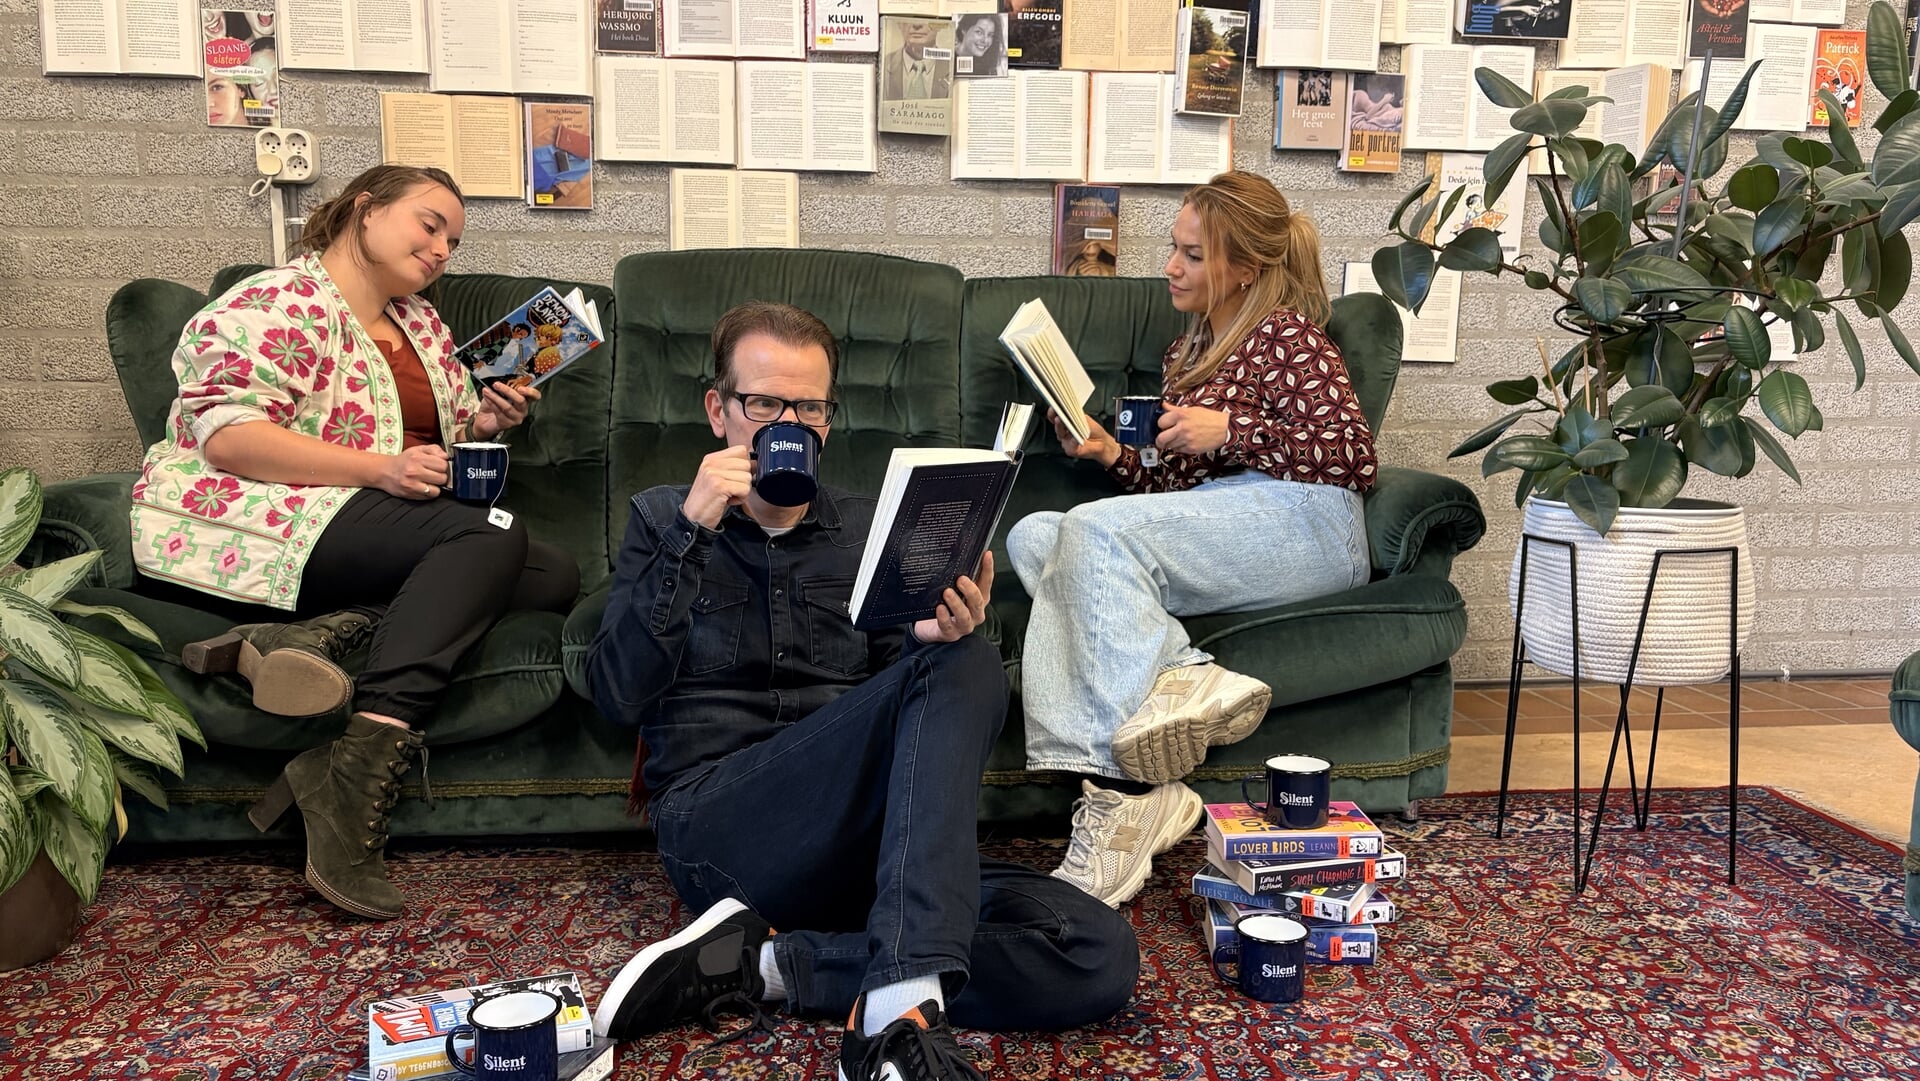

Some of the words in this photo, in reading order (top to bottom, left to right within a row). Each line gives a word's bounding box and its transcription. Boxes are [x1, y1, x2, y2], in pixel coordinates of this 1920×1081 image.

[603, 10, 652, 21] HERBJØRG
[828, 14, 864, 24] KLUUN
[1017, 13, 1061, 21] ERFGOED
[599, 22, 641, 31] WASSMO
[820, 26, 871, 36] HAANTJES
[206, 43, 248, 55] SLOANE
[1825, 41, 1860, 54] Patrick
[213, 54, 242, 65] sisters
[889, 107, 945, 119] SARAMAGO
[1291, 108, 1309, 121] Het
[1311, 110, 1336, 121] grote
[1302, 119, 1323, 128] feest
[1349, 128, 1365, 151] het
[1367, 130, 1400, 156] portret
[1448, 175, 1466, 184] Dede
[531, 299, 563, 327] SLAYER
[542, 294, 572, 320] DEMON
[770, 439, 804, 453] Silent
[467, 467, 497, 479] Silent
[1279, 791, 1314, 805] Silent
[1233, 842, 1268, 855] LOVER
[1271, 841, 1306, 854] BIRDS
[1310, 839, 1336, 851] LEANN
[1289, 873, 1314, 888] SUCH
[1316, 868, 1355, 885] CHARMING
[1199, 886, 1230, 900] HEIST
[1232, 892, 1274, 908] ROYALE
[1262, 963, 1297, 978] Silent
[410, 1058, 451, 1073] TEGENBOSC
[483, 1053, 527, 1070] Silent
